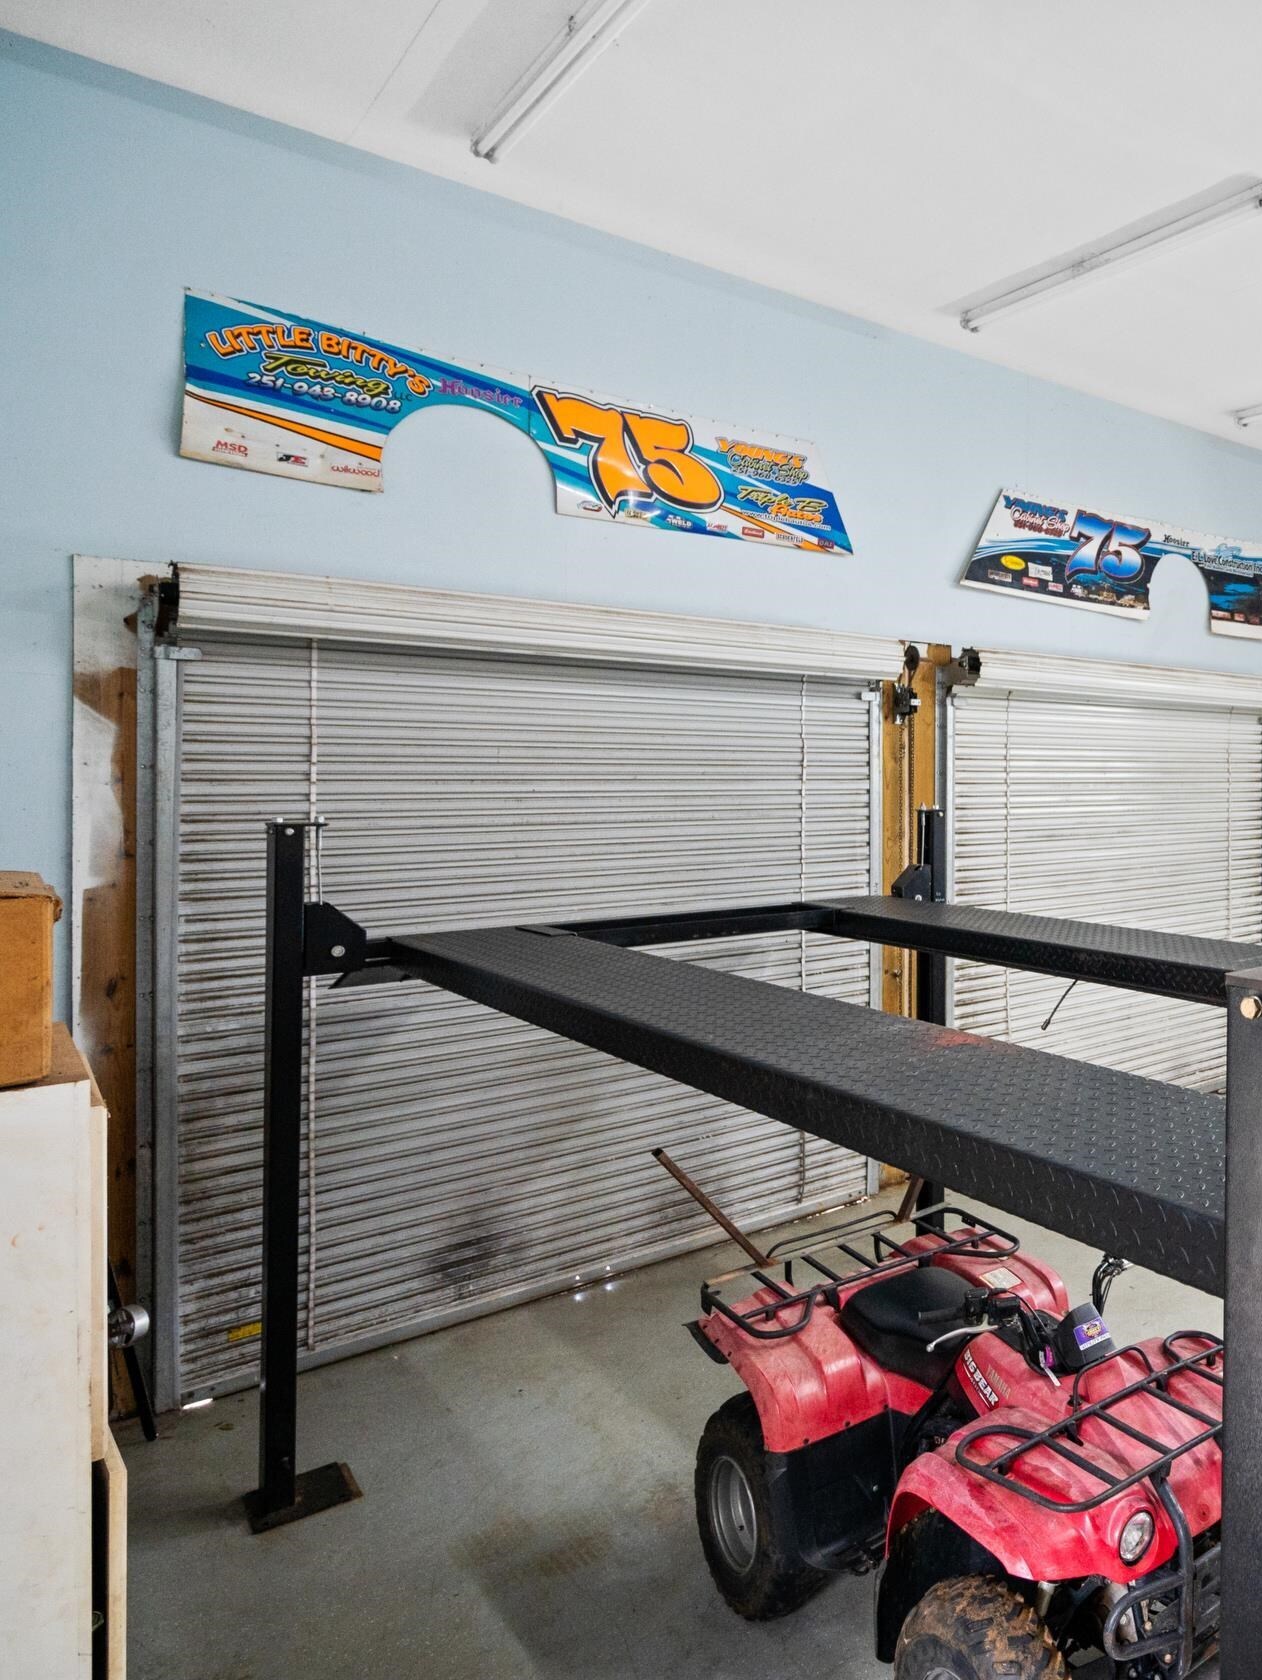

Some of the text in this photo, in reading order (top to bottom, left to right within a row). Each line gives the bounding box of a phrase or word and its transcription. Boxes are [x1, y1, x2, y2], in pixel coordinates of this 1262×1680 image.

[207, 324, 434, 397] LITTLE BITTY'S
[260, 351, 392, 398] Towing
[246, 372, 402, 414] 251-943-8908
[214, 440, 249, 454] MSD
[531, 385, 725, 519] 75
[729, 452, 810, 482] Cabinet Shop
[737, 486, 829, 514] Triple B
[670, 519, 693, 528] WELD
[1010, 506, 1071, 536] Cabinet Shop
[1065, 509, 1152, 584] 75
[973, 1368, 999, 1407] BEAR
[986, 1363, 1011, 1400] YAMAHA
